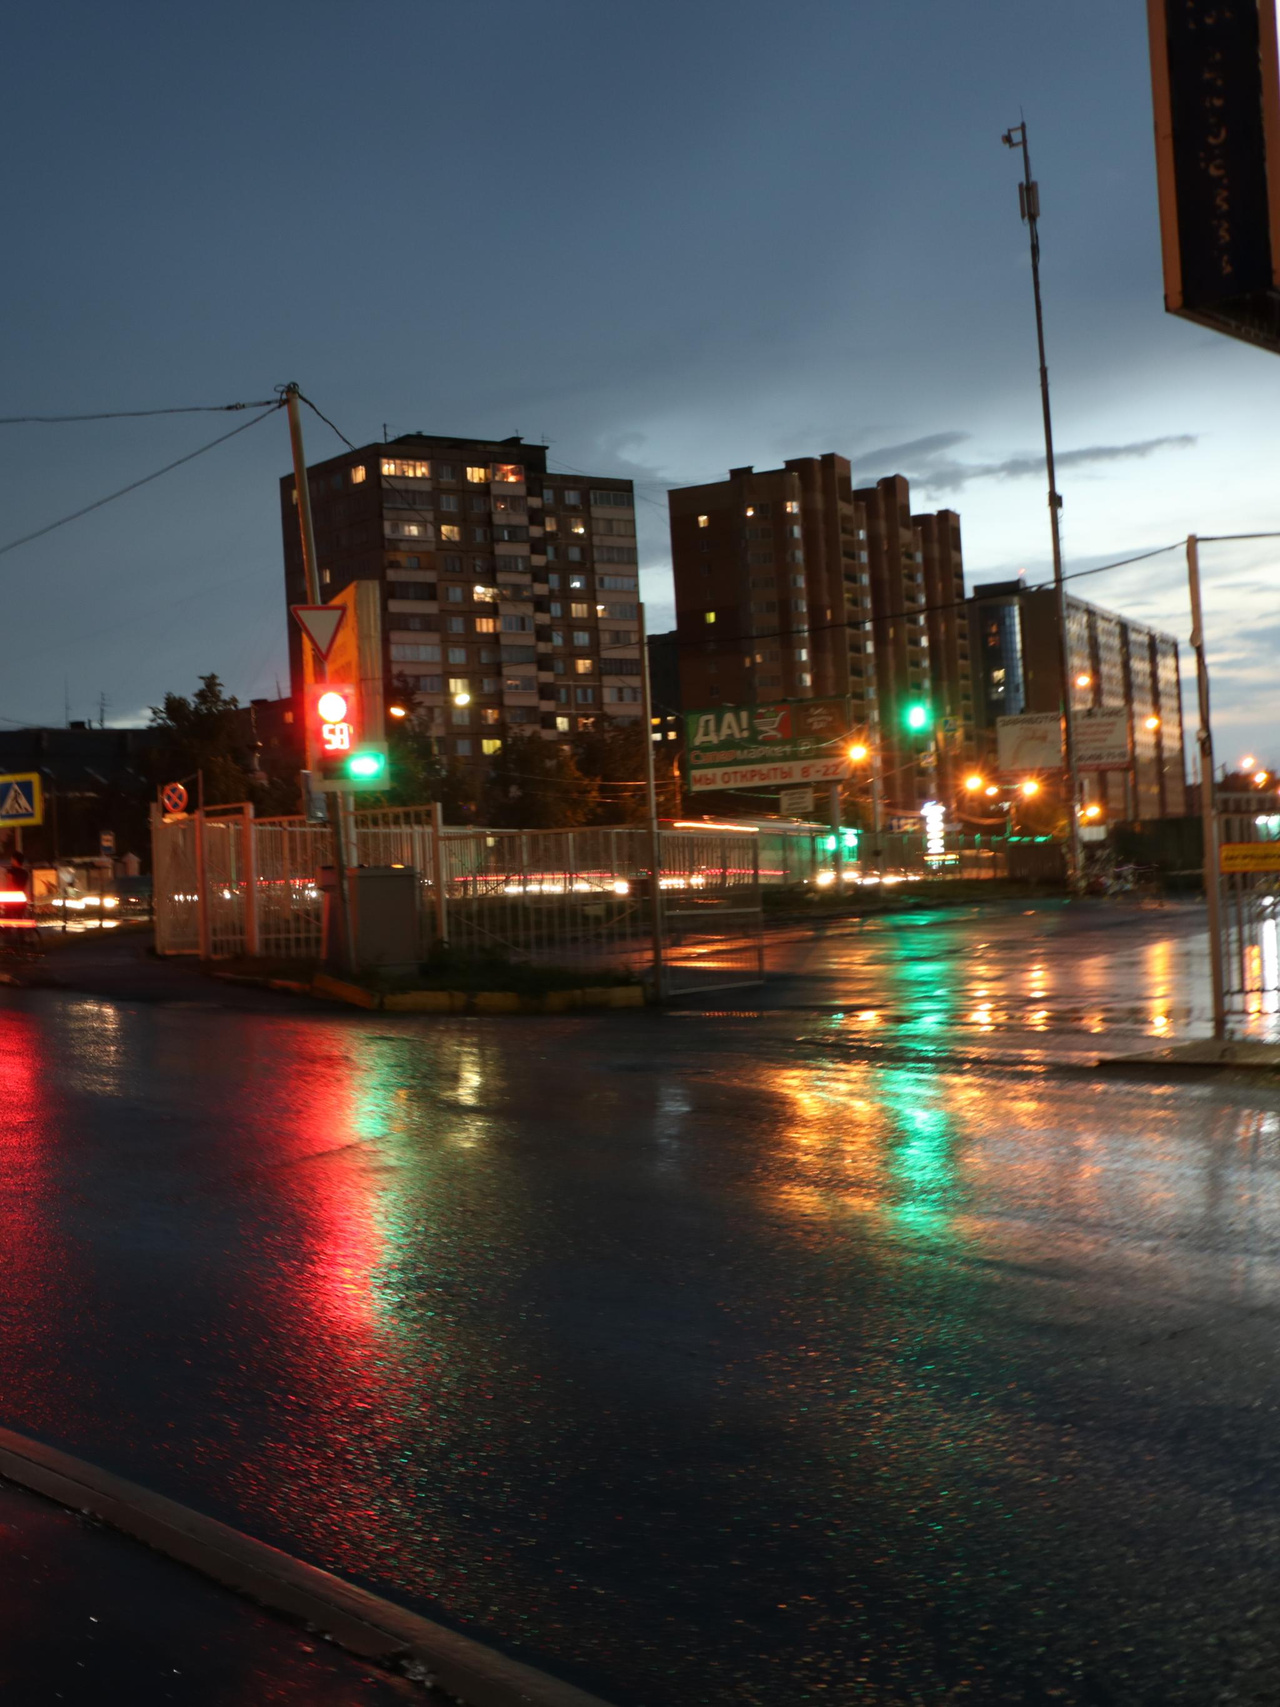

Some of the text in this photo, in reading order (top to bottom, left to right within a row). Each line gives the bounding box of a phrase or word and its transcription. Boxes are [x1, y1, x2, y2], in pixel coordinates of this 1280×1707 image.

[322, 723, 350, 750] 58
[694, 710, 750, 746] ДА!
[692, 773, 717, 787] МЫ
[721, 767, 794, 784] ОТКРЫТЫ
